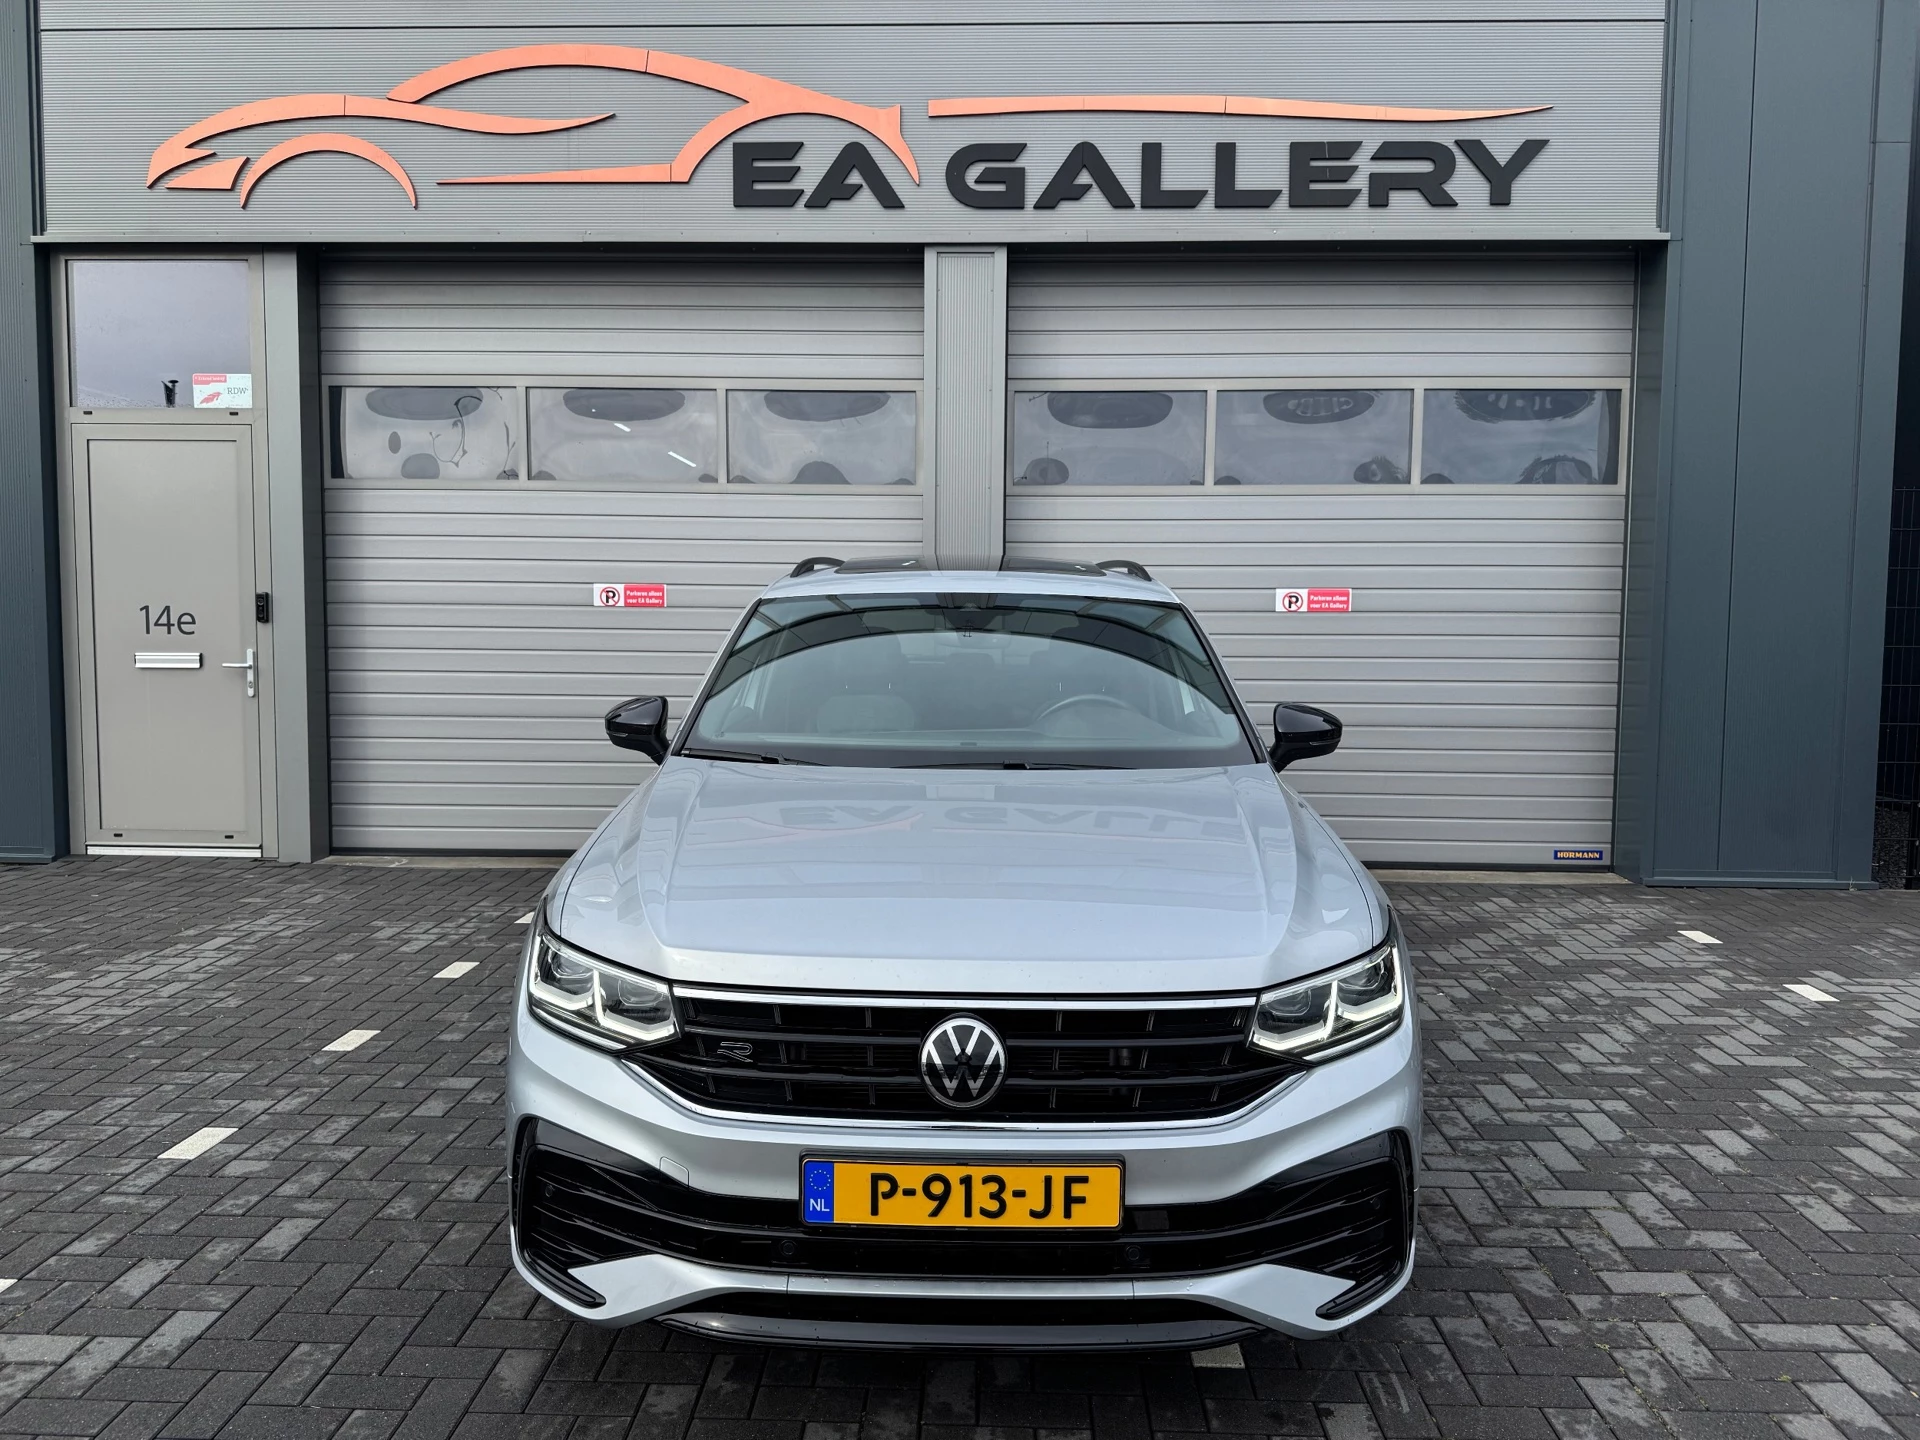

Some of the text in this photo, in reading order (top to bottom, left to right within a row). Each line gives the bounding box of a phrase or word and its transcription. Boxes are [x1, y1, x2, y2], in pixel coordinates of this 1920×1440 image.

[733, 139, 1550, 209] EA GALLERY
[227, 387, 247, 395] RDW
[139, 605, 197, 635] 14e
[809, 1199, 830, 1212] NL
[870, 1173, 1090, 1219] P-913-JF
